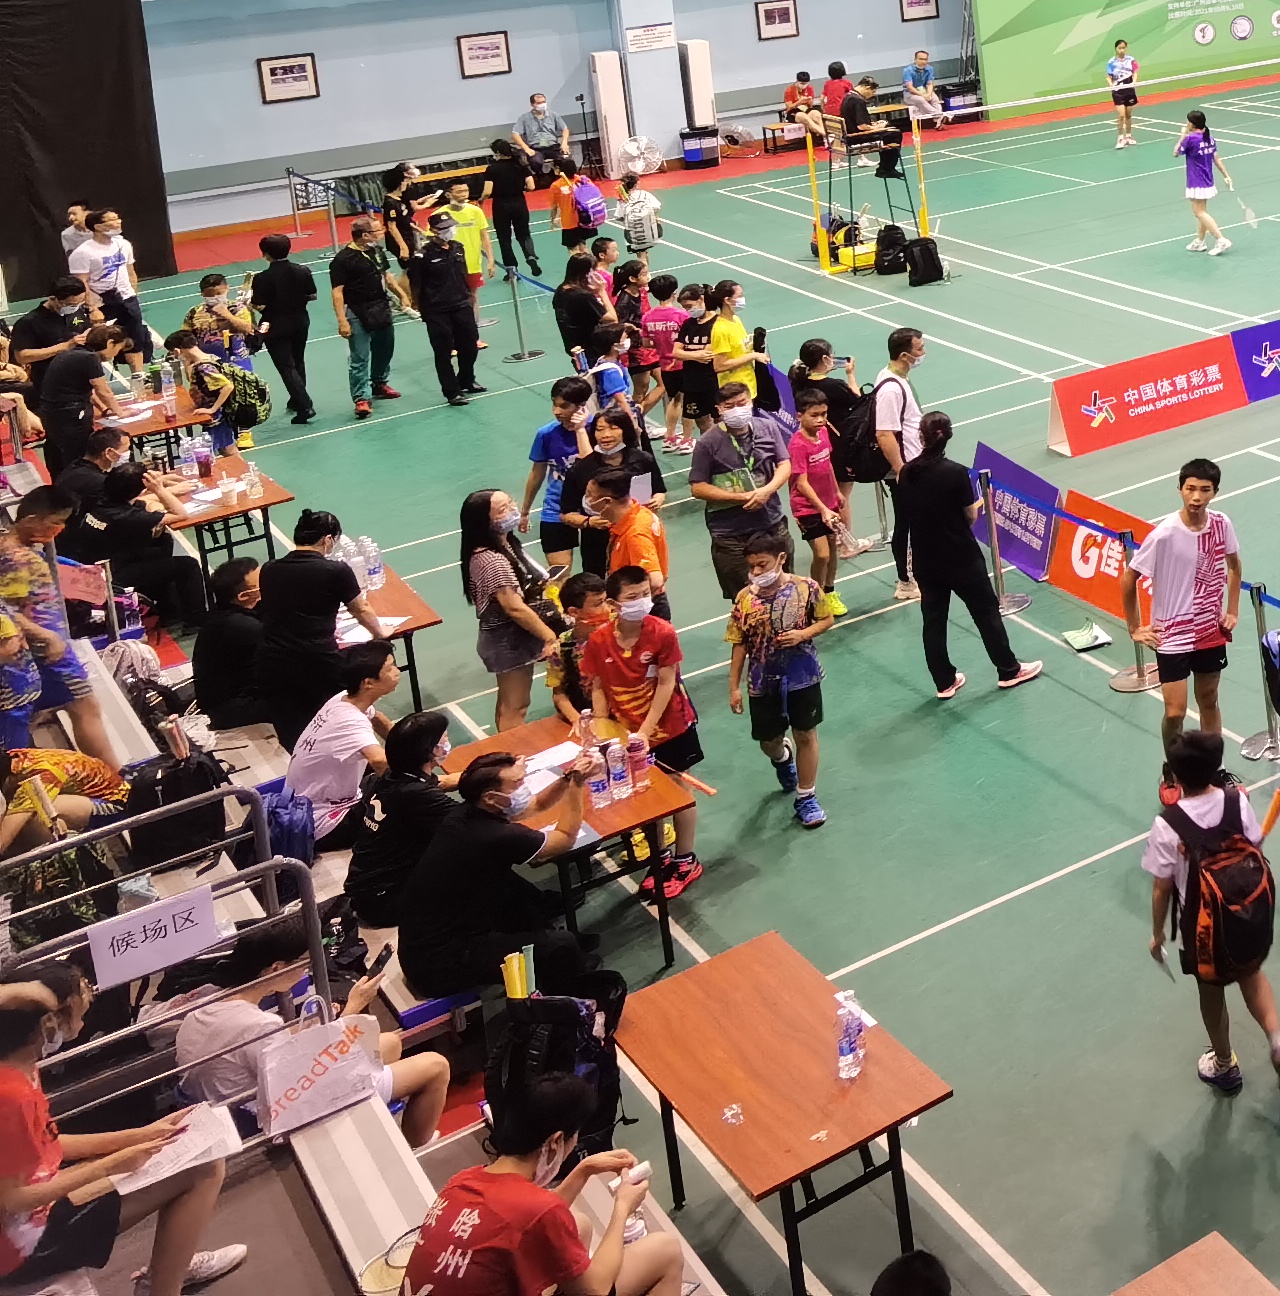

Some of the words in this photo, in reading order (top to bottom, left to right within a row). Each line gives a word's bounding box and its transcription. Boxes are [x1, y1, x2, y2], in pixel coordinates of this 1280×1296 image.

[1124, 363, 1222, 405] 中国体育彩票
[1128, 405, 1155, 417] CHINA
[1155, 393, 1188, 409] SPORTS
[1189, 383, 1224, 399] LOTTERY
[995, 489, 1047, 538] 中国体育彩票
[108, 907, 199, 958] 候场区
